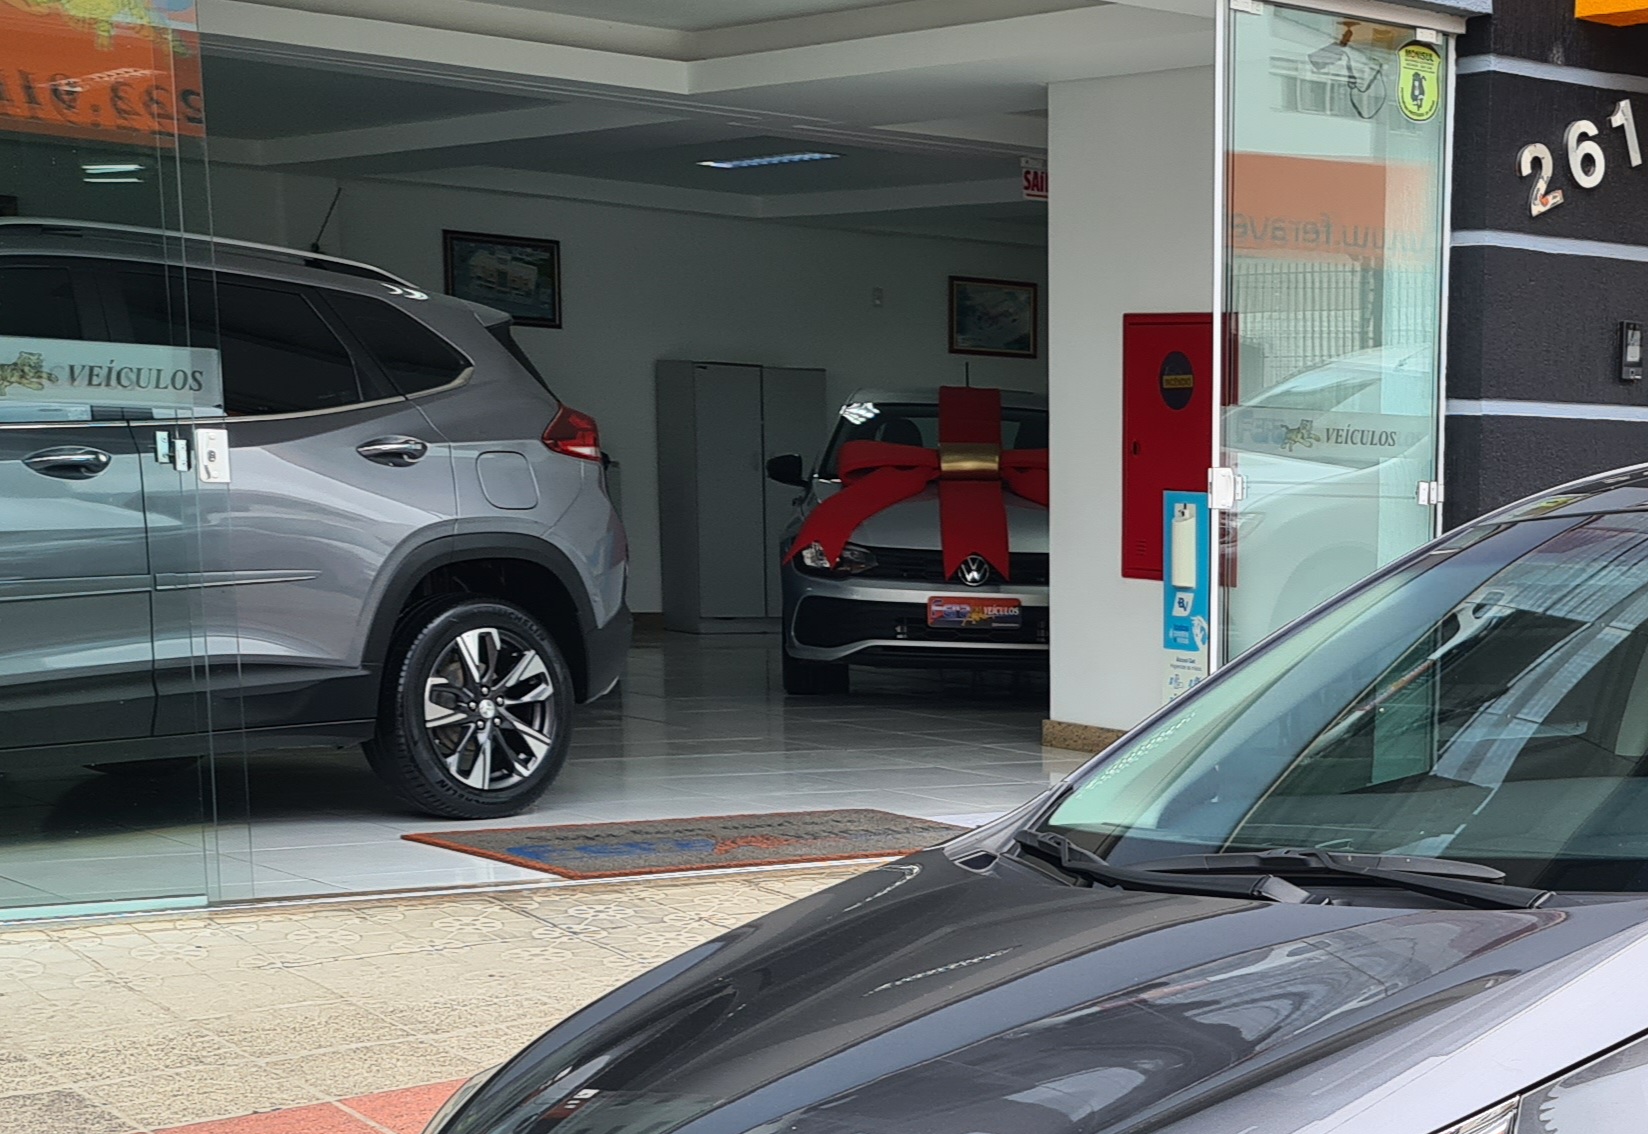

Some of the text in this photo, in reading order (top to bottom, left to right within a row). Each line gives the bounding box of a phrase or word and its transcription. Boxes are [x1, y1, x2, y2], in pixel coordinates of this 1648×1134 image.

[1516, 99, 1643, 217] 261
[1023, 170, 1048, 192] SAÍ
[67, 359, 204, 391] VEÍCULOS
[1325, 424, 1397, 447] VEÍCULOS
